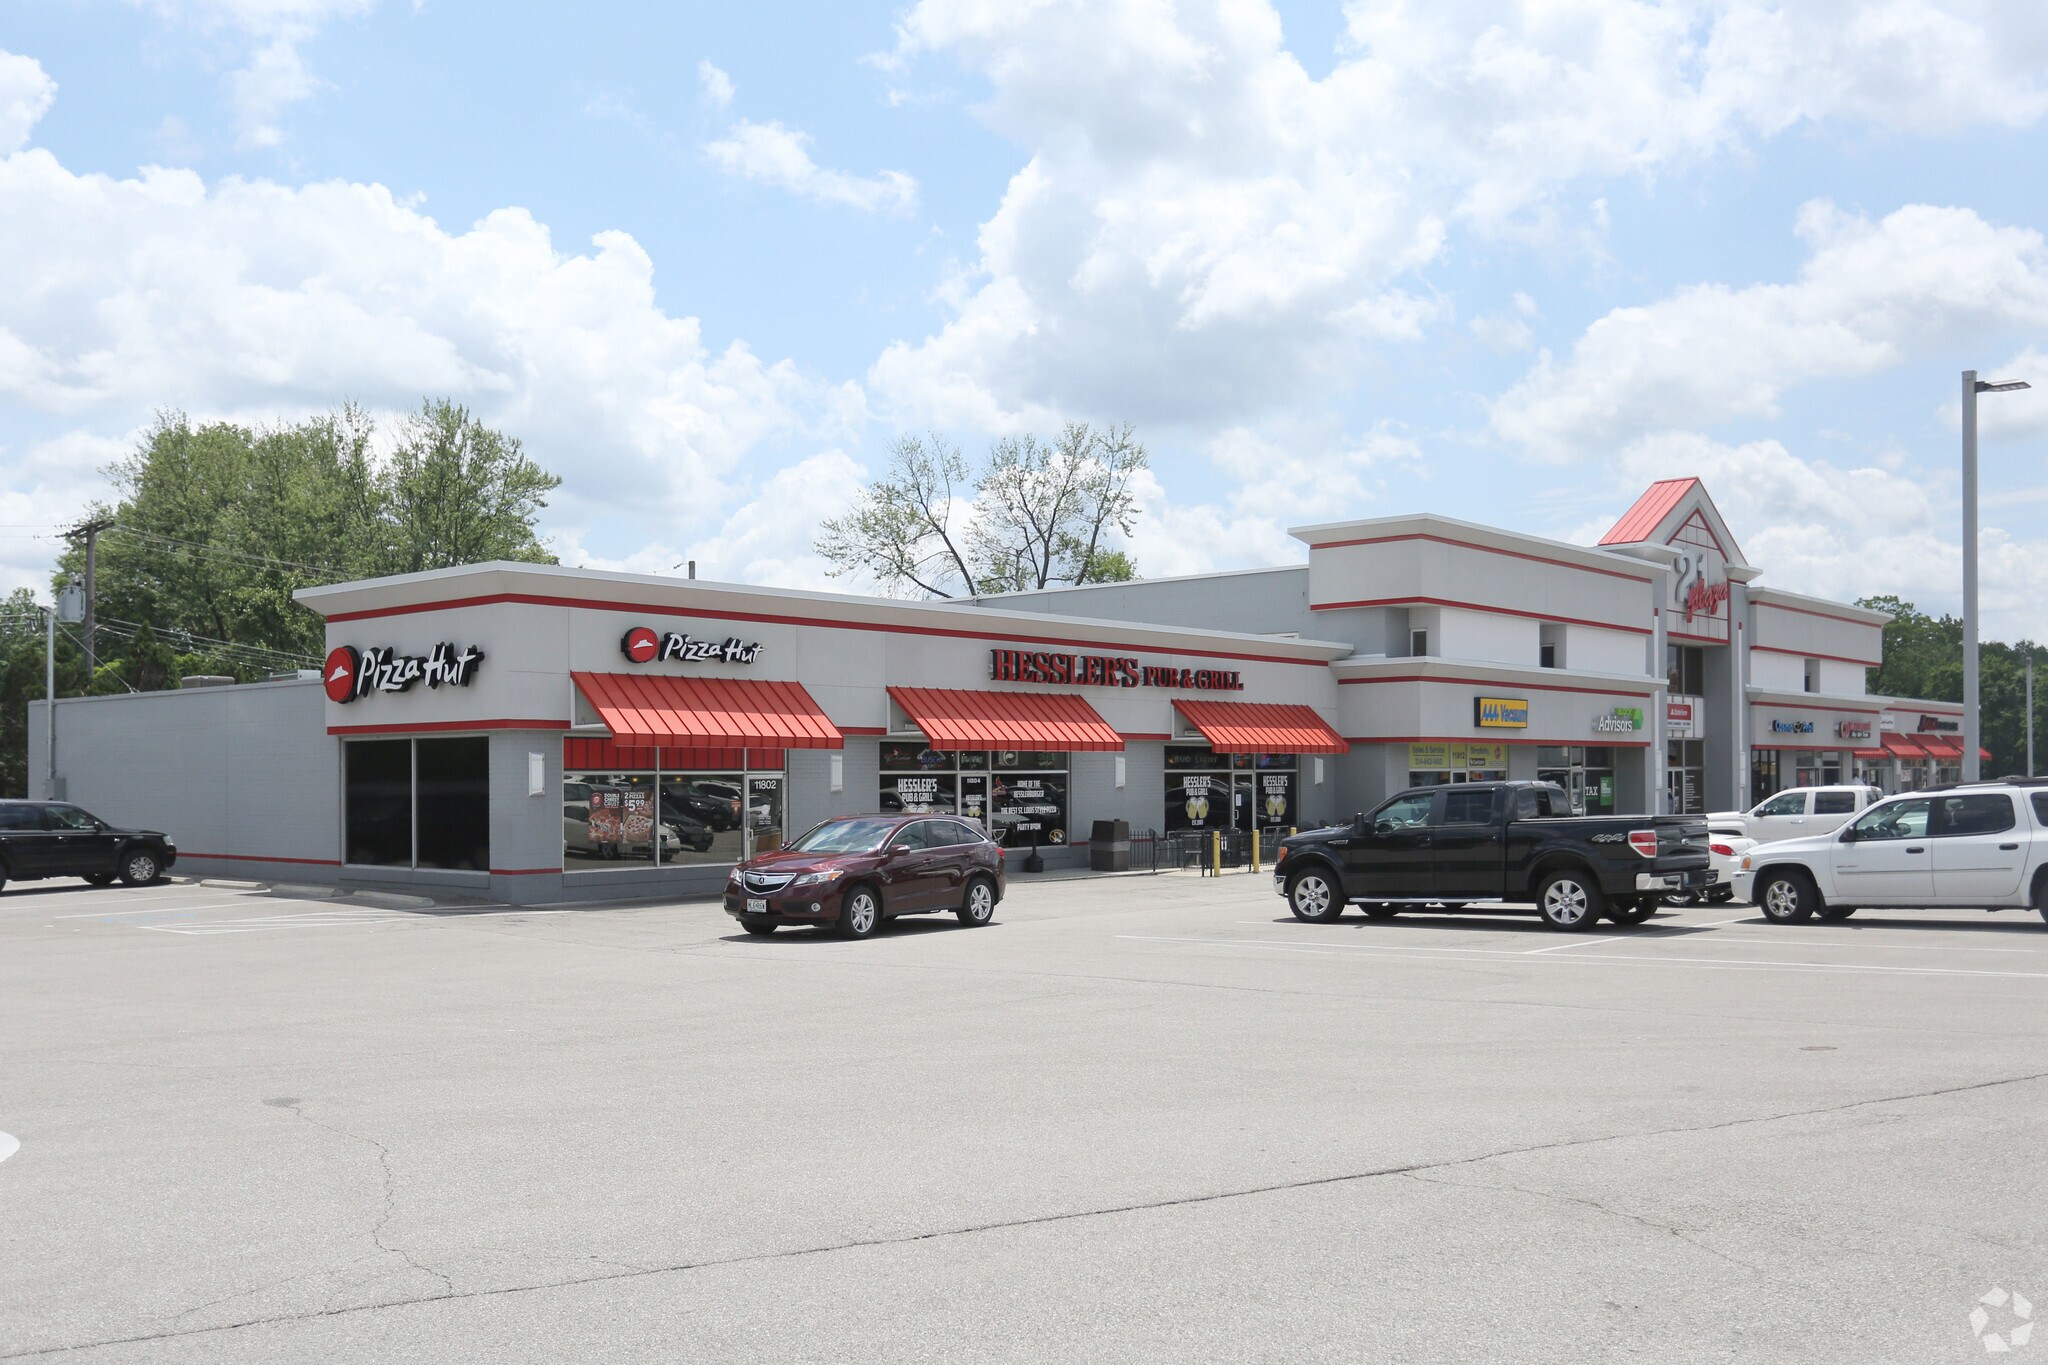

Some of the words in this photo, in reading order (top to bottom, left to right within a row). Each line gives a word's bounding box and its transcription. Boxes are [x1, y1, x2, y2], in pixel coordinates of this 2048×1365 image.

[664, 633, 722, 661] Pizza
[725, 638, 766, 663] Hut
[357, 649, 421, 696] Pizza
[423, 645, 477, 687] Hut
[993, 649, 1140, 688] HESSLER'S
[1143, 666, 1179, 688] PUB
[1181, 668, 1195, 689] &
[1195, 669, 1244, 691] GRILL
[1481, 703, 1500, 722] AAA
[1500, 704, 1528, 723] Vacuum
[1598, 716, 1633, 732] Advisors
[754, 780, 777, 790] 11802
[897, 778, 938, 793] HESSLER'S
[1183, 776, 1211, 788] HESSLER'S
[1262, 775, 1288, 787] HESSLER'S
[901, 793, 914, 802] PUB
[913, 793, 919, 802] &
[918, 792, 934, 802] GRILL
[1585, 786, 1598, 796] TAX
